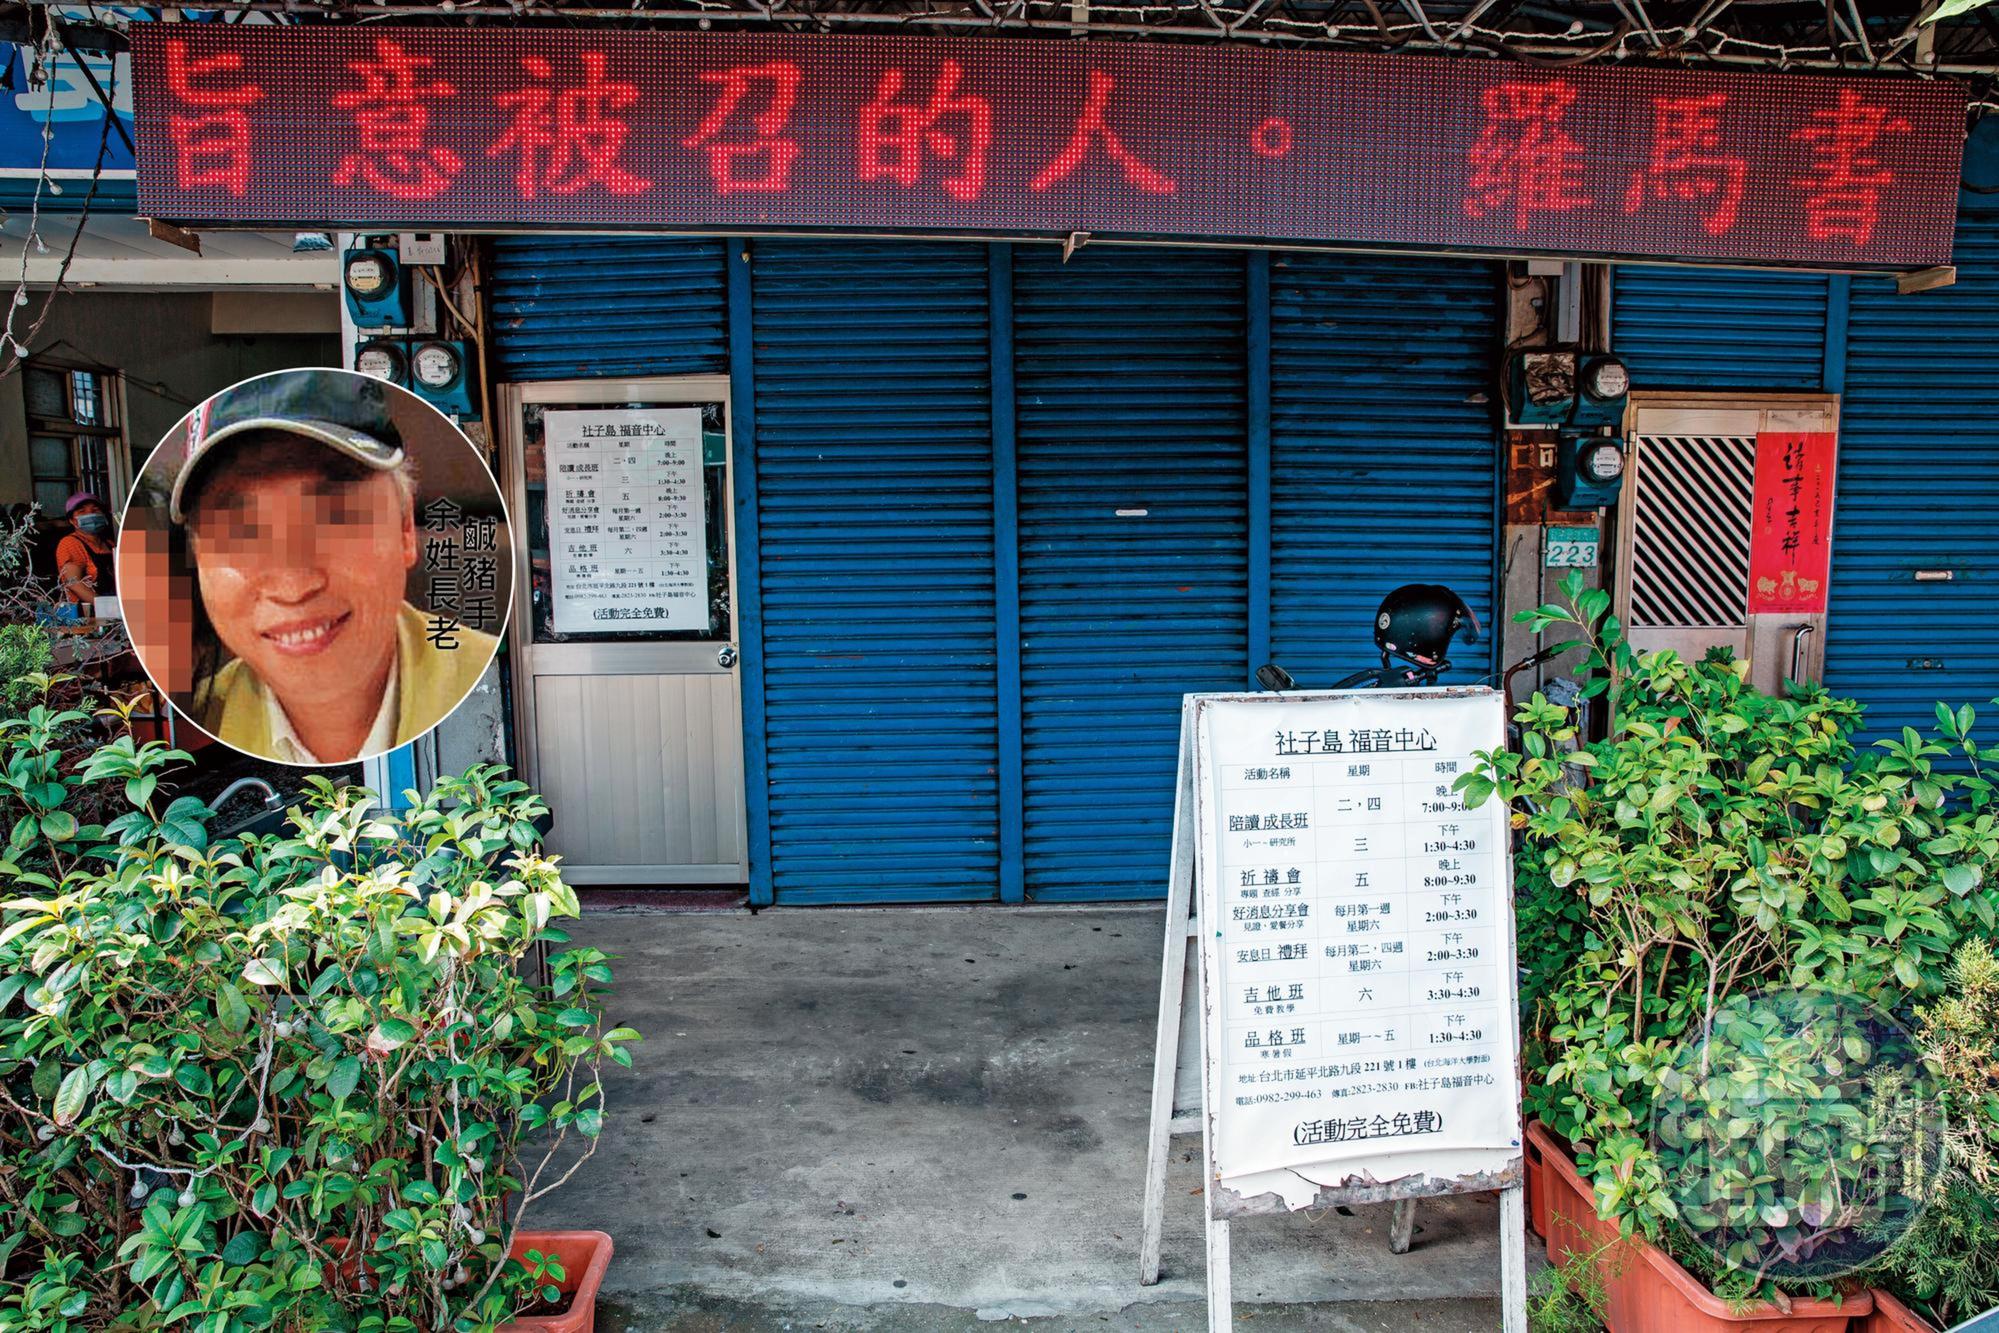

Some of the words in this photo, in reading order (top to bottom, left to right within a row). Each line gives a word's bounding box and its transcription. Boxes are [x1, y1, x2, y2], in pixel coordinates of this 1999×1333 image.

[1463, 80, 1912, 246] 羅馬書
[1549, 545, 1595, 563] 223
[1275, 729, 1343, 754] 社子島
[1349, 727, 1437, 752] 福音中心
[1244, 767, 1291, 781] 活動名稱
[1347, 764, 1370, 778] 星期
[1435, 761, 1457, 773] 時間
[1422, 801, 1473, 813] 7:00~9:0
[1229, 814, 1263, 831] 陪讀
[1264, 812, 1308, 830] 成長班
[1438, 824, 1459, 836] 下午
[1354, 838, 1368, 852] 三
[1424, 840, 1475, 853] 1:30~4:30
[1438, 858, 1461, 871] 晚上
[1240, 868, 1301, 885] 祈禱會
[1355, 873, 1369, 887] 五
[1424, 874, 1476, 887] 8:00~9:30
[1440, 893, 1462, 905] 下午
[1233, 902, 1310, 920] 好消息分享會
[1335, 902, 1391, 918] 每月第一週
[1425, 909, 1477, 923] 2:00~3:30
[1347, 920, 1381, 933] 星期六
[1441, 932, 1463, 944] 下午
[1237, 948, 1271, 963] 安息日
[1277, 943, 1308, 961] 禮拜
[1427, 948, 1479, 962] 2:00~3:30
[1348, 960, 1383, 973] 星期六
[1442, 971, 1464, 983] 下午
[1244, 983, 1304, 1003] 吉他班
[1358, 988, 1373, 1001] 六
[1427, 986, 1480, 1001] 3:30~4:30
[1444, 1014, 1466, 1026] 下午
[1245, 1028, 1305, 1047] 品格班
[1429, 1029, 1482, 1044] 1:30~4:30
[1293, 1110, 1443, 1146] (活動完全免費)
